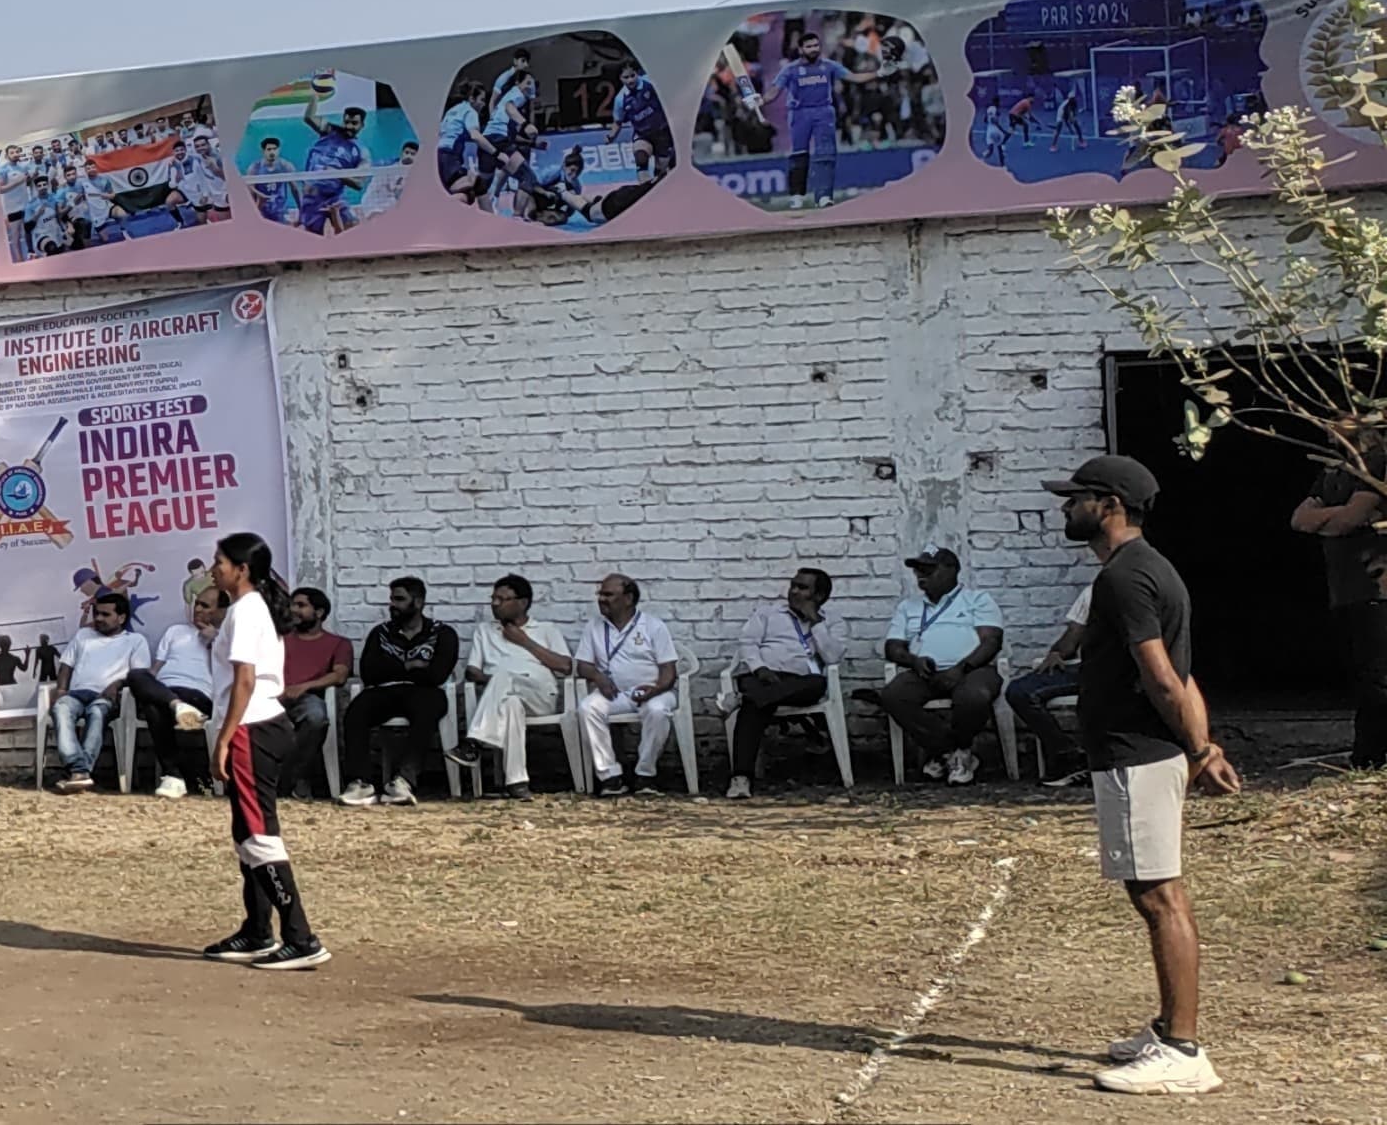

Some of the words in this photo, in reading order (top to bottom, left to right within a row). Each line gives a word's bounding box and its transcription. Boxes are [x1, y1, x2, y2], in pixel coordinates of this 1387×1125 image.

[1088, 2, 1129, 24] 2024
[573, 80, 615, 119] 12
[4, 324, 41, 336] EMPIRE
[43, 314, 98, 330] EDUCATION
[4, 329, 96, 357] INSTITUTE
[101, 324, 124, 345] OF
[129, 312, 220, 341] AIRCRAFT
[17, 344, 141, 377] ENGINEERING
[91, 403, 153, 425] SPORTS
[156, 397, 193, 418] FEST
[79, 419, 200, 465] INDIRA
[82, 454, 239, 502] PREMIER
[86, 494, 218, 540] LEAGUE
[11, 538, 19, 547] of
